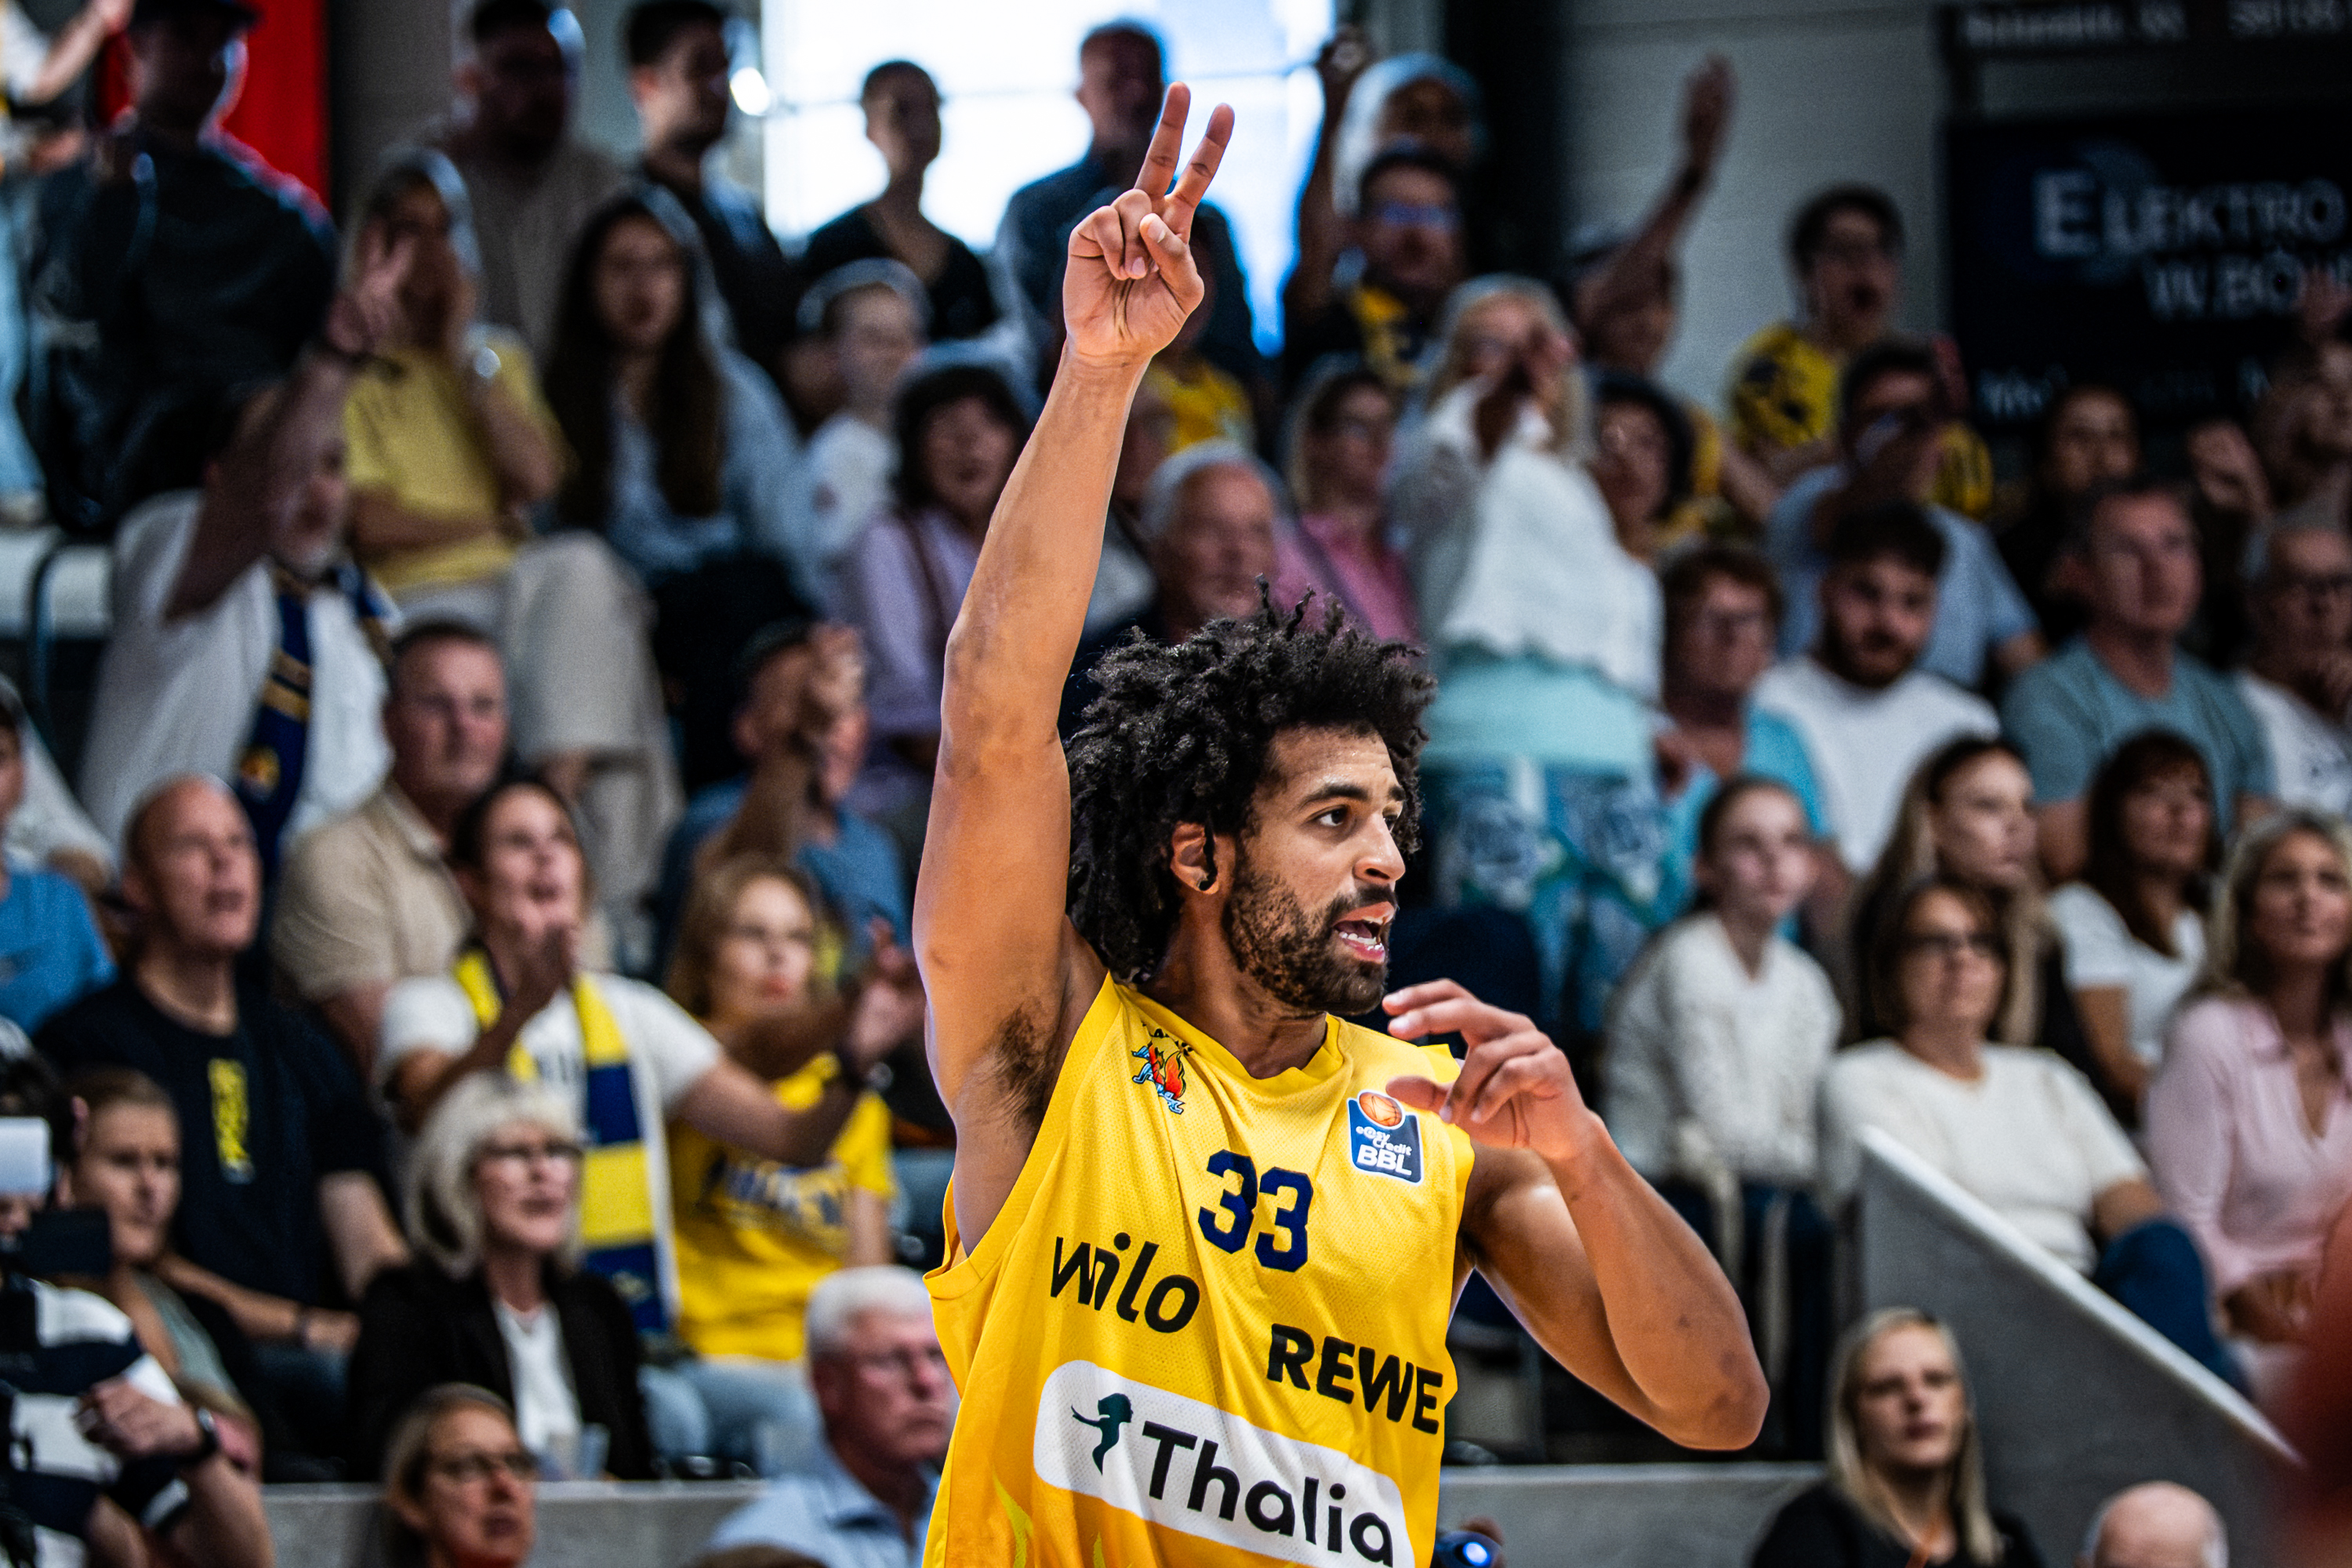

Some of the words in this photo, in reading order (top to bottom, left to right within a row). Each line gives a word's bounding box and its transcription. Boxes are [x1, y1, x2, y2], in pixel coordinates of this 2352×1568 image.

[2034, 168, 2346, 260] ELEKTRO
[1197, 1149, 1314, 1272] 33
[1356, 1144, 1412, 1176] BBL
[1050, 1232, 1200, 1334] wilo
[1266, 1323, 1443, 1435] REWE
[1142, 1420, 1393, 1568] Thalia
